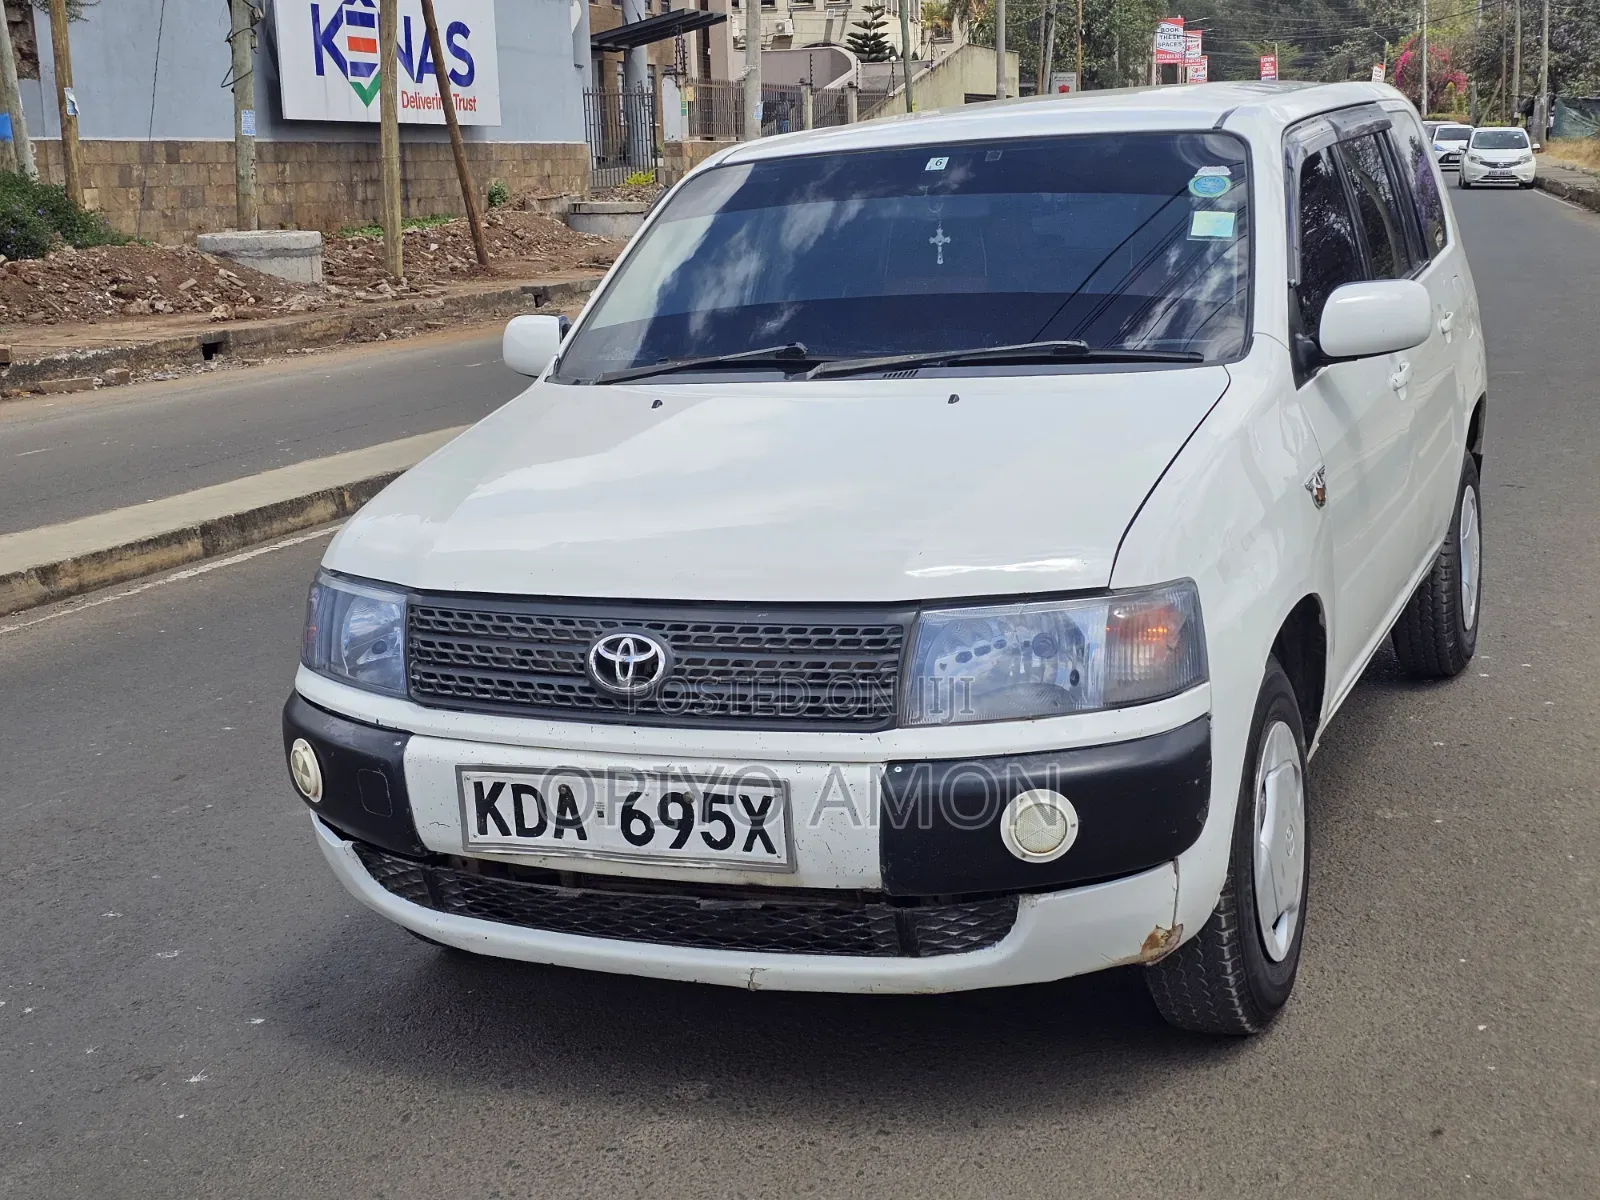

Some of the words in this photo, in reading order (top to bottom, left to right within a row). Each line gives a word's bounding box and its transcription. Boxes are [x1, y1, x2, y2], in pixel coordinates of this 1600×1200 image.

[401, 90, 448, 111] Deliverin
[453, 93, 477, 112] Trust
[935, 158, 943, 167] 6
[473, 780, 588, 841] KDA
[620, 790, 778, 855] 695X
